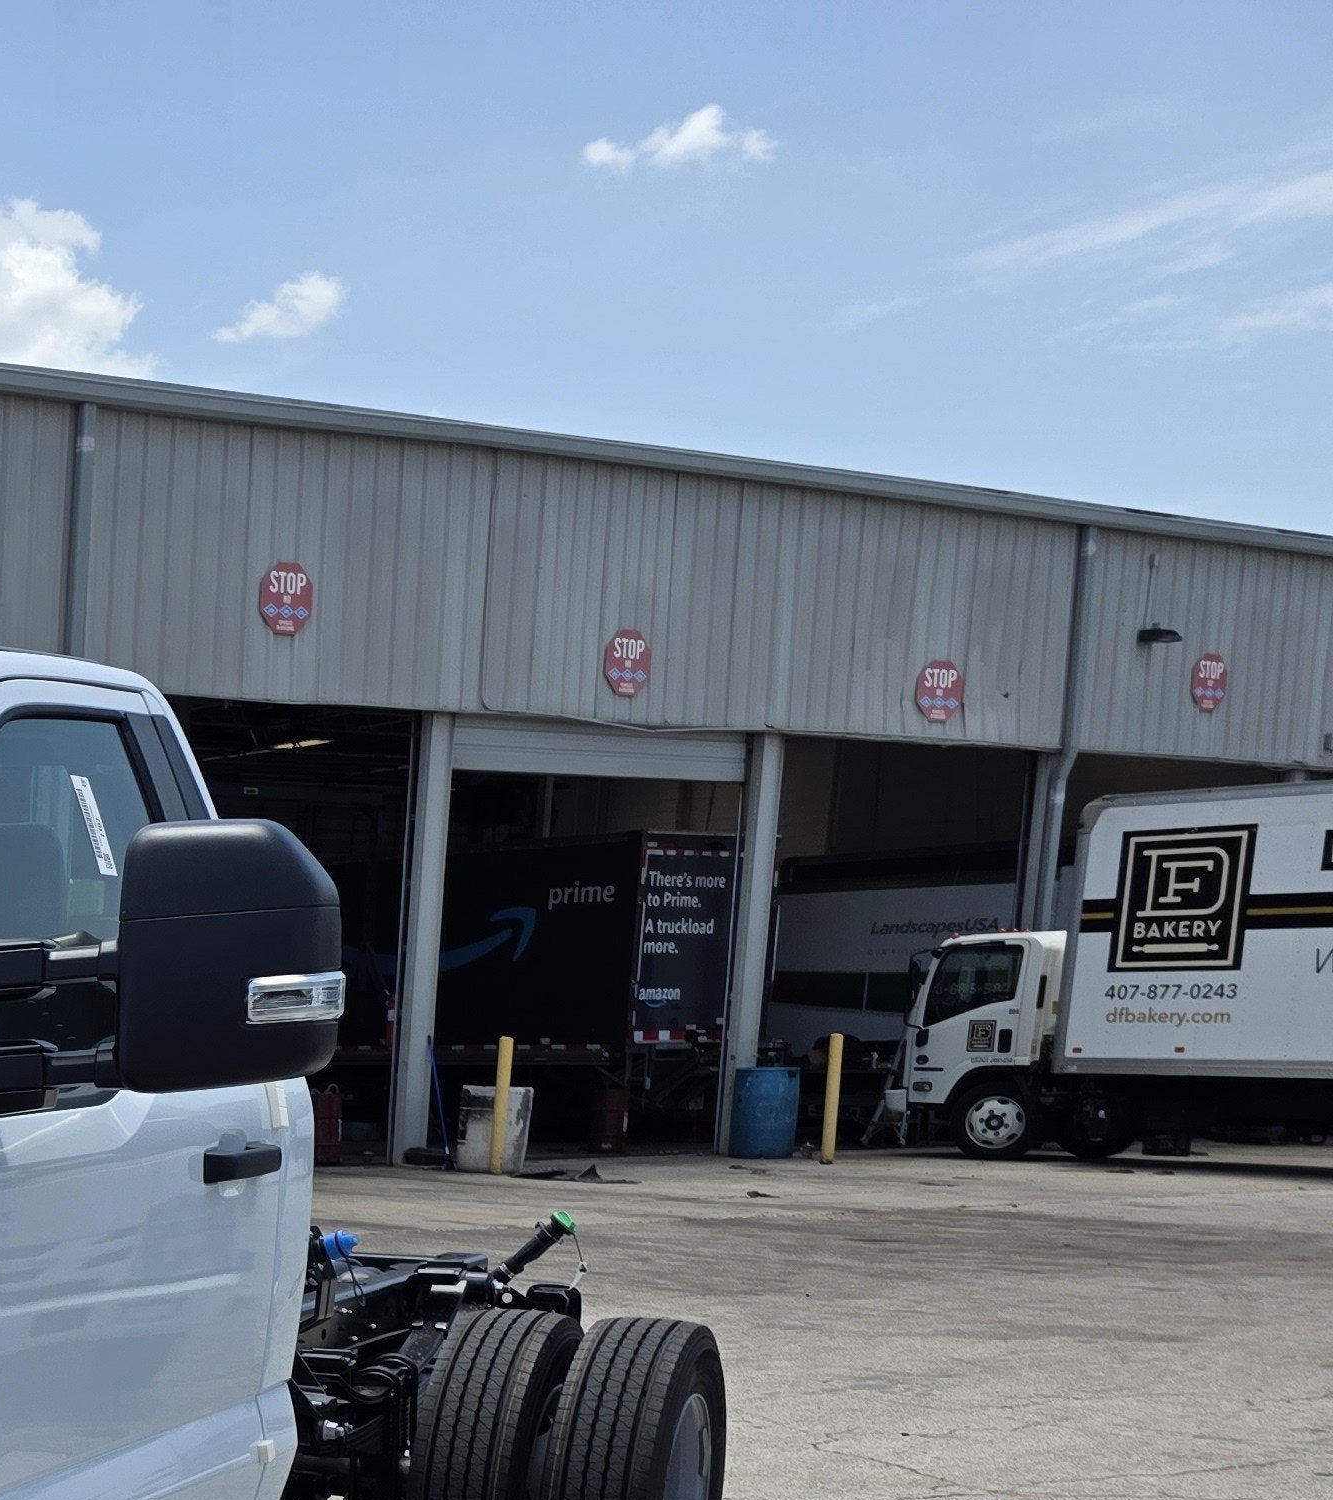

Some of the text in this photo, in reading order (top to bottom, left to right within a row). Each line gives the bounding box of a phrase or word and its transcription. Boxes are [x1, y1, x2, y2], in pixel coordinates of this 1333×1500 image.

[269, 570, 308, 595] STOP
[613, 637, 646, 660] STOP
[924, 667, 958, 689] STOP
[1198, 659, 1225, 680] STOP
[648, 870, 726, 889] There's more
[548, 881, 616, 910] prime
[647, 892, 702, 908] to Prime.
[645, 918, 714, 935] A truckload
[870, 916, 999, 937] LandscapesUSA
[1132, 919, 1223, 940] BAKERY
[643, 938, 679, 955] more.
[638, 986, 681, 1001] amazon
[1104, 982, 1239, 1001] 407-877-0243
[1105, 1007, 1232, 1025] dfbakery.com
